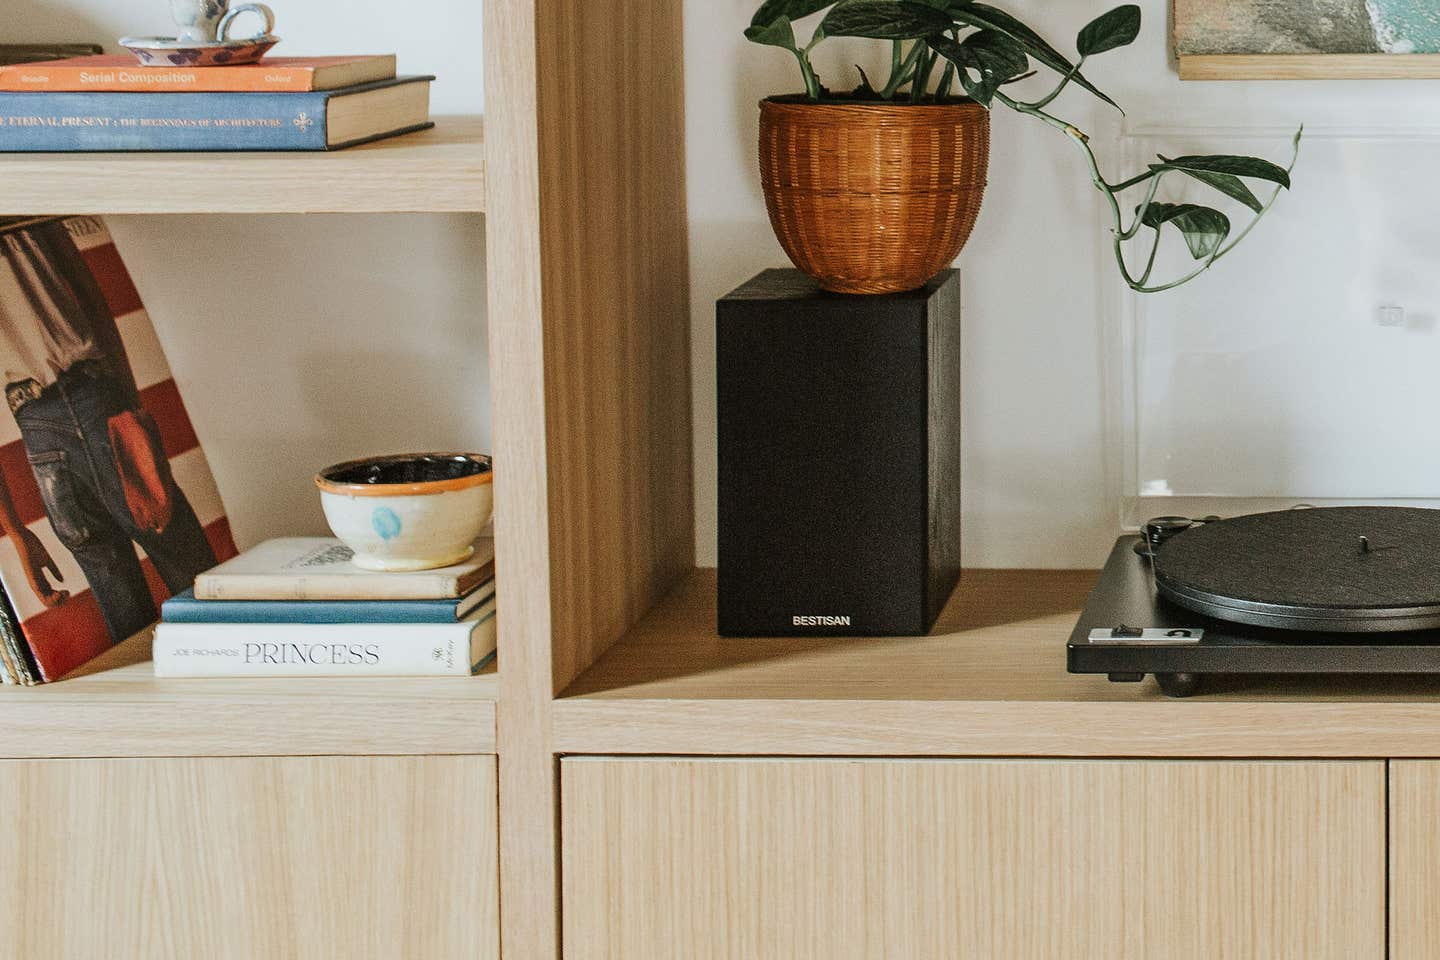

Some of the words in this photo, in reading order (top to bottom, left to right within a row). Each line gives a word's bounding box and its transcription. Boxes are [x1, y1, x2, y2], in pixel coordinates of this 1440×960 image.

[80, 71, 114, 82] Serial
[119, 71, 196, 85] Composition
[793, 615, 850, 626] BESTISAN
[244, 642, 381, 665] PRINCESS
